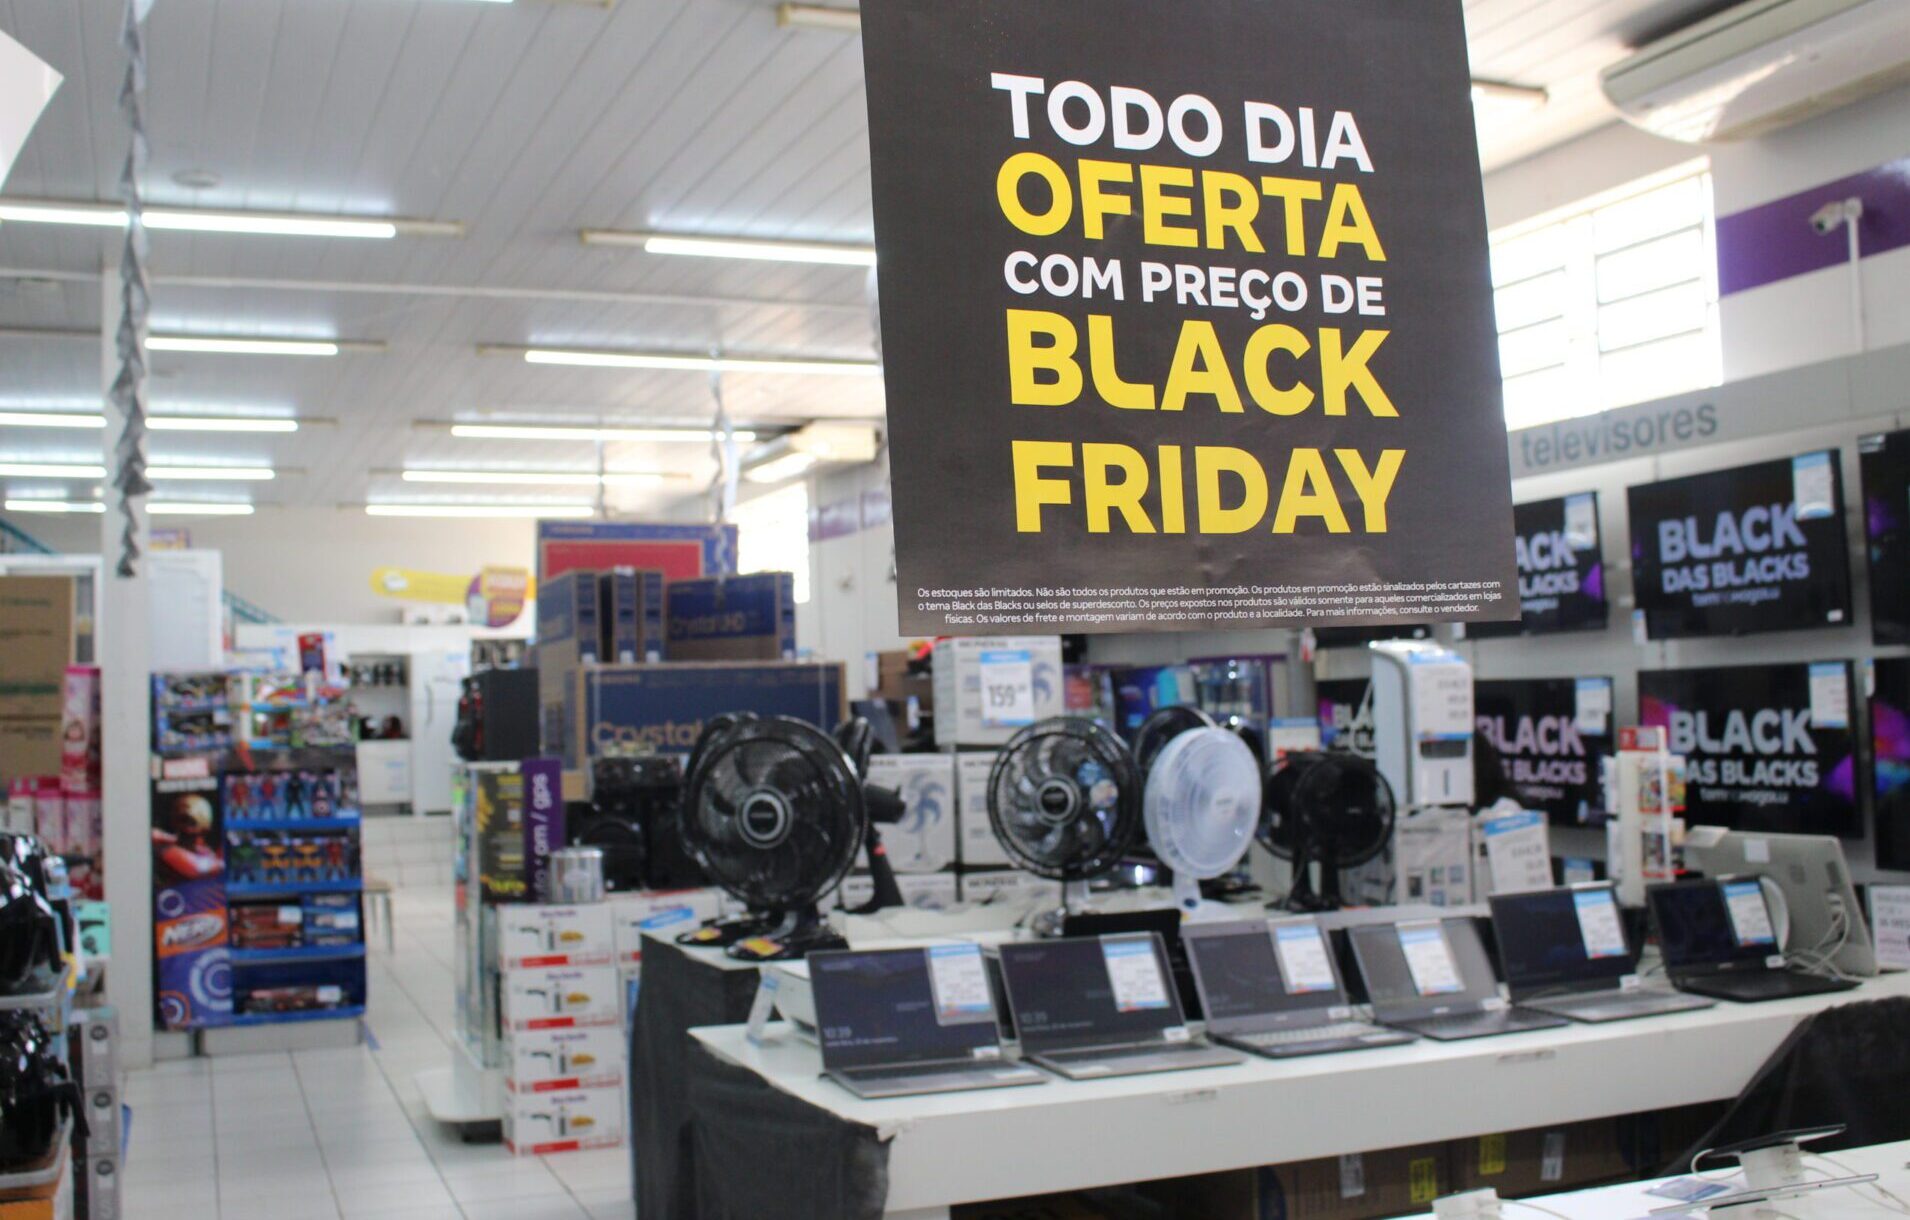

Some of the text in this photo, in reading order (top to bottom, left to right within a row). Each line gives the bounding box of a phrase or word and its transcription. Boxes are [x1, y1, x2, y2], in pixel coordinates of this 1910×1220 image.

[991, 72, 1374, 173] TODO DIA
[996, 152, 1386, 261] OFERTA
[1003, 251, 1386, 320] COM PREÇO DE
[1006, 309, 1399, 417] BLACK
[1521, 403, 1718, 468] televisores
[1012, 440, 1406, 534] FRIDAY
[1515, 530, 1577, 572] ACK
[1657, 502, 1808, 564] BLACK
[918, 588, 930, 597] Os
[931, 588, 973, 599] estoques
[974, 588, 989, 597] são
[991, 588, 1034, 597] limitados.
[1036, 588, 1053, 597] Não
[1055, 587, 1070, 597] são
[1072, 587, 1097, 596] todos
[1099, 588, 1109, 596] os
[1110, 587, 1149, 598] produtos
[1150, 588, 1166, 597] que
[1167, 586, 1190, 596] estão
[1206, 586, 1249, 597] promoção.
[1251, 585, 1262, 594] Os
[1263, 585, 1301, 596] produtos
[1317, 583, 1358, 595] promoção
[1359, 582, 1382, 592] estão
[1383, 582, 1424, 591] sinalizados
[1426, 582, 1446, 592] pelos
[1447, 581, 1481, 590] cartazes
[1482, 581, 1500, 589] com
[1518, 570, 1580, 597] LACKS
[1661, 552, 1811, 593] DAS BLACKS
[926, 602, 950, 610] tema
[952, 601, 975, 610] Black
[976, 601, 993, 610] das
[994, 601, 1022, 610] Blacks
[1023, 602, 1035, 610] ou
[1036, 600, 1058, 609] selos
[1059, 600, 1070, 609] de
[1072, 599, 1137, 610] superdesconto.
[1138, 599, 1149, 608] Os
[1151, 600, 1178, 610] preços
[1180, 599, 1216, 609] expostos
[1218, 599, 1232, 607] nos
[1234, 597, 1272, 608] produtos
[1273, 597, 1288, 606] são
[1289, 596, 1317, 605] válidos
[1318, 596, 1353, 605] somente
[1355, 596, 1373, 605] para
[1374, 594, 1405, 604] aqueles
[1406, 592, 1468, 602] comercializados
[1484, 591, 1502, 602] lojas
[944, 614, 975, 624] físicas.
[976, 614, 988, 623] Os
[989, 613, 1021, 623] valores
[1022, 613, 1033, 622] de
[1035, 613, 1057, 622] frete
[1066, 613, 1114, 624] montagem
[1115, 612, 1144, 621] variam
[1146, 611, 1156, 620] de
[1158, 611, 1186, 620] acordo
[1214, 610, 1248, 620] produto
[1262, 608, 1305, 618] localidade.
[1306, 608, 1324, 616] Para
[1326, 608, 1345, 616] mais
[1346, 606, 1398, 616] informações,
[1400, 605, 1433, 614] consulte
[1440, 604, 1479, 612] vendedor.
[1669, 708, 1819, 755] BLACK
[532, 772, 554, 810] gps
[1513, 758, 1587, 786] BLACKS
[1685, 758, 1819, 787] AS BLACKS
